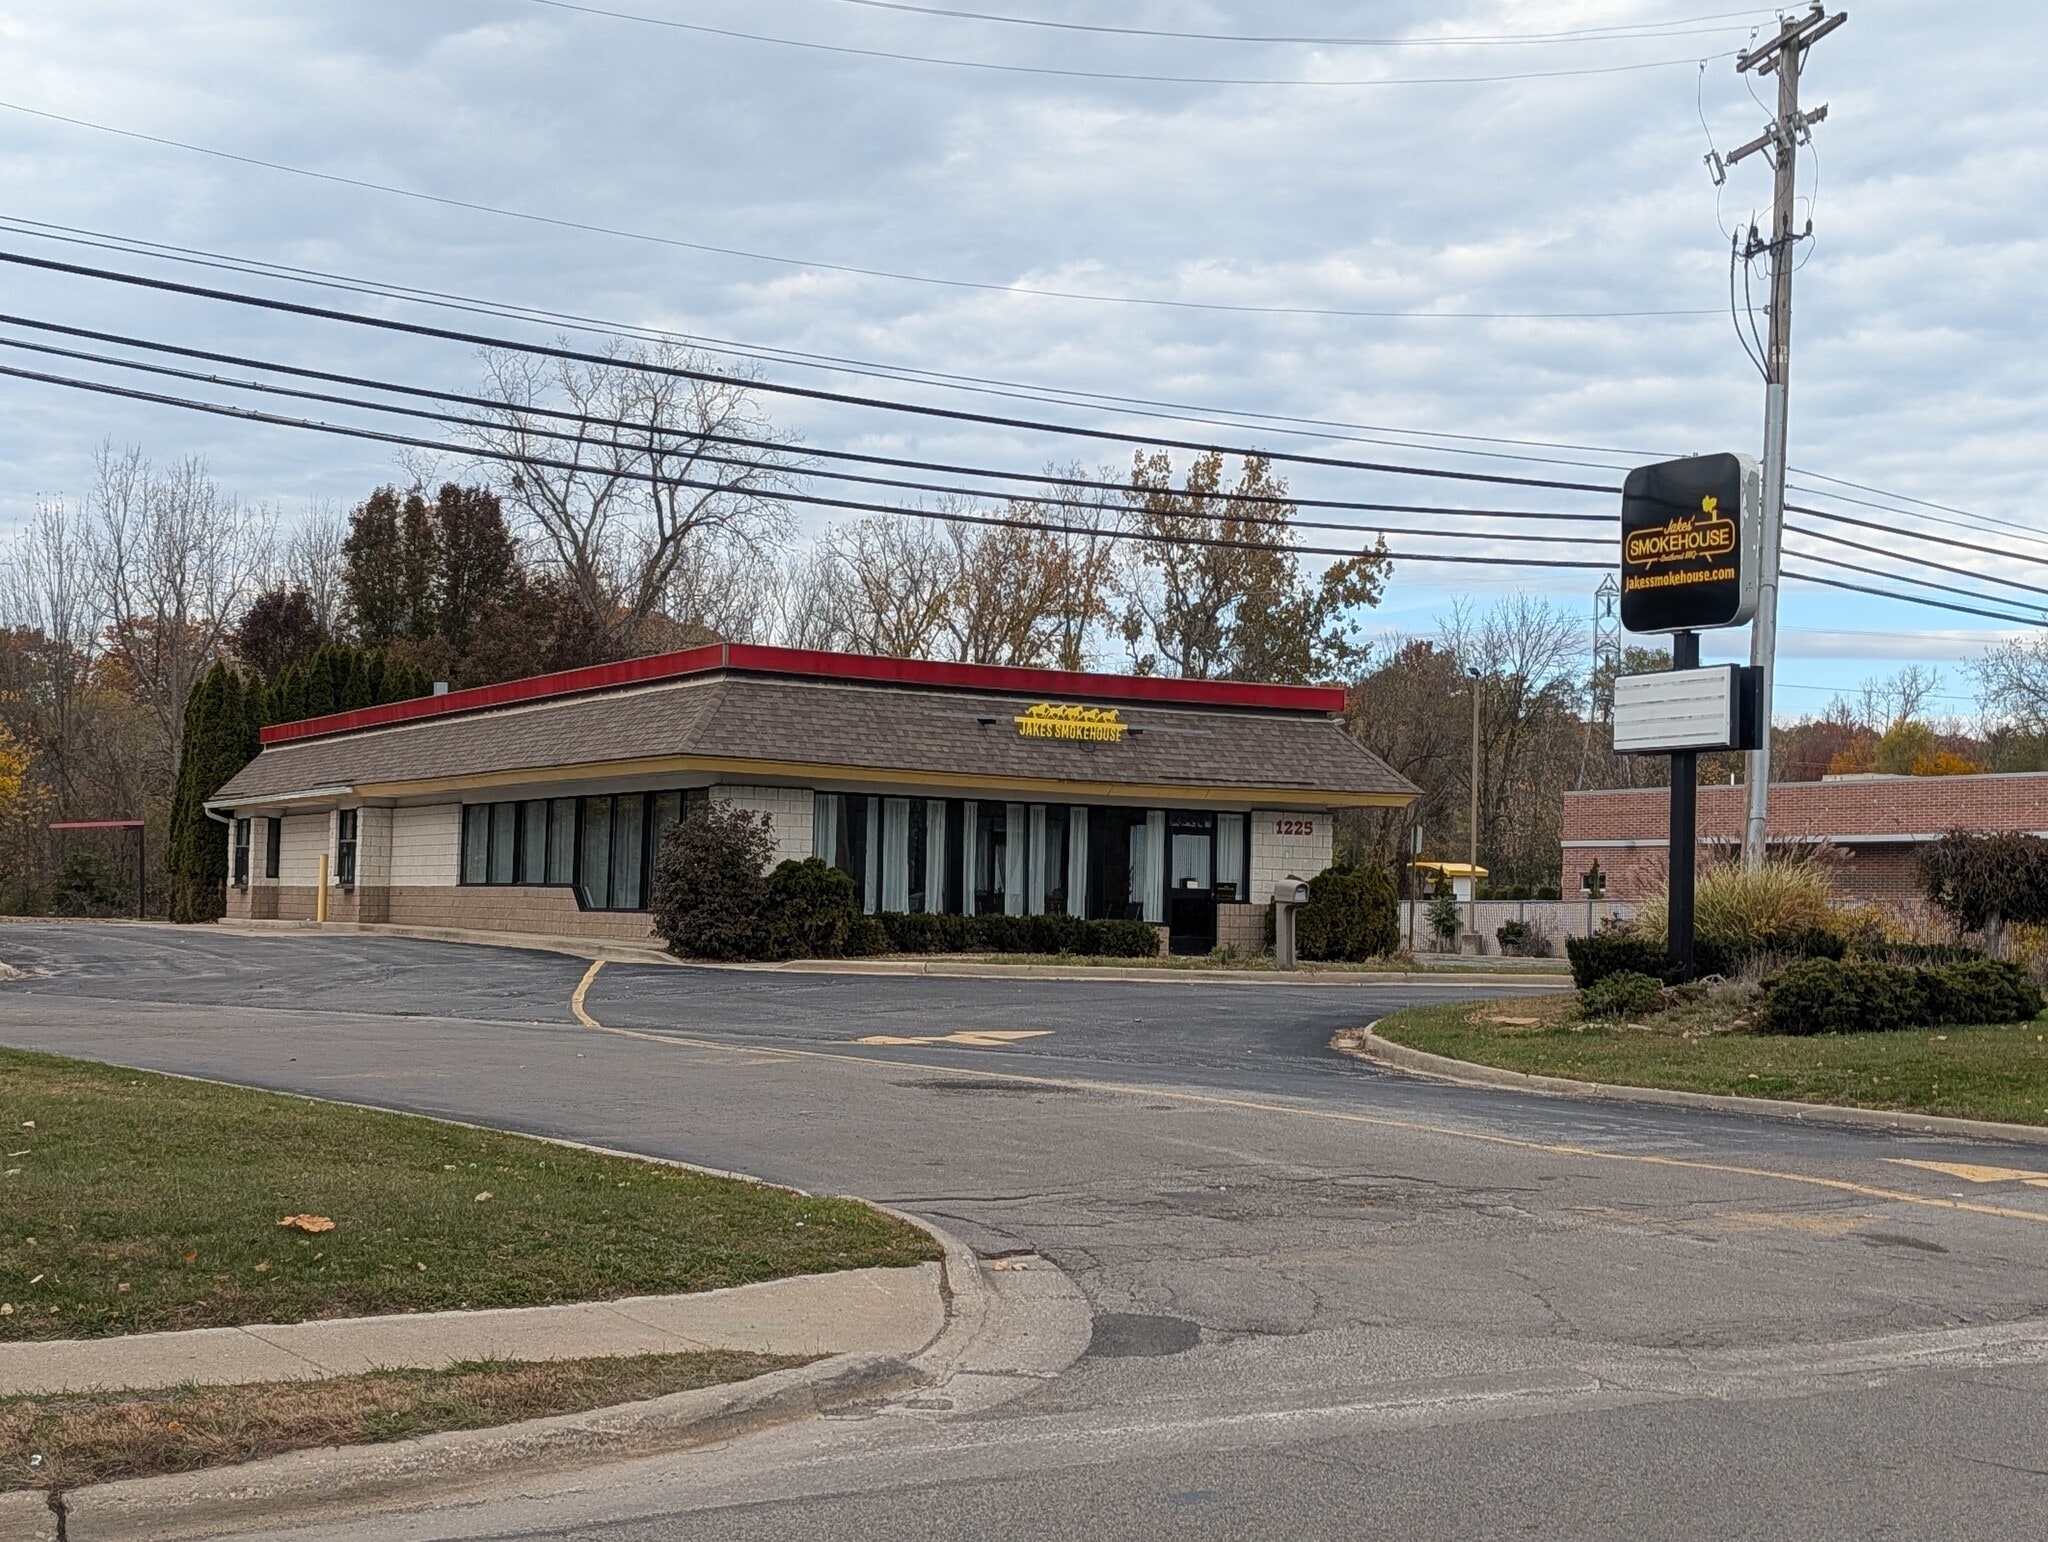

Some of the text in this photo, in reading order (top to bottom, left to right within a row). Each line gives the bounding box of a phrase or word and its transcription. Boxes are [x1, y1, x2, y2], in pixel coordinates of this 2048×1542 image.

[1630, 528, 1729, 556] SMOKEHOUSE
[1625, 568, 1735, 593] jakessmokehouse.com
[1019, 721, 1122, 742] JAKES SMOKEHOUSE
[1276, 820, 1313, 836] 1225
